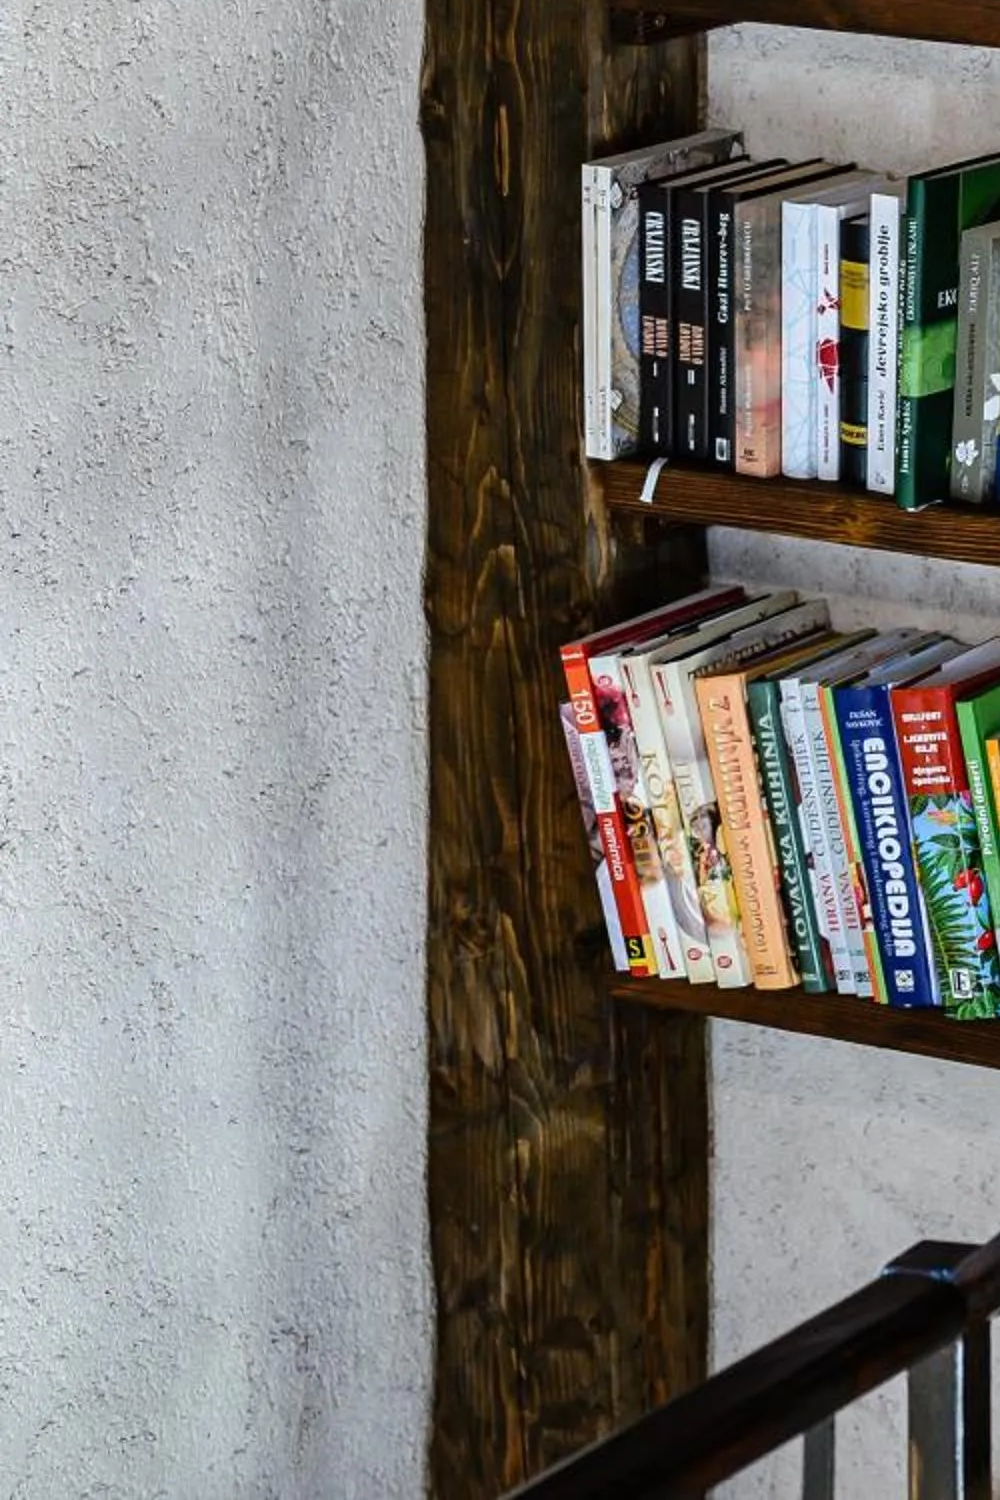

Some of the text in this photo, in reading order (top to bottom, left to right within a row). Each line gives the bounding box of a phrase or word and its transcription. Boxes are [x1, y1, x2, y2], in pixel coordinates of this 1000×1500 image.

[717, 213, 731, 323] Gazi Husrev-beg
[877, 224, 892, 286] groblje
[568, 685, 595, 726] 150
[755, 711, 810, 952] LOVAČKA KUHINJA
[974, 804, 992, 855] Prirodni
